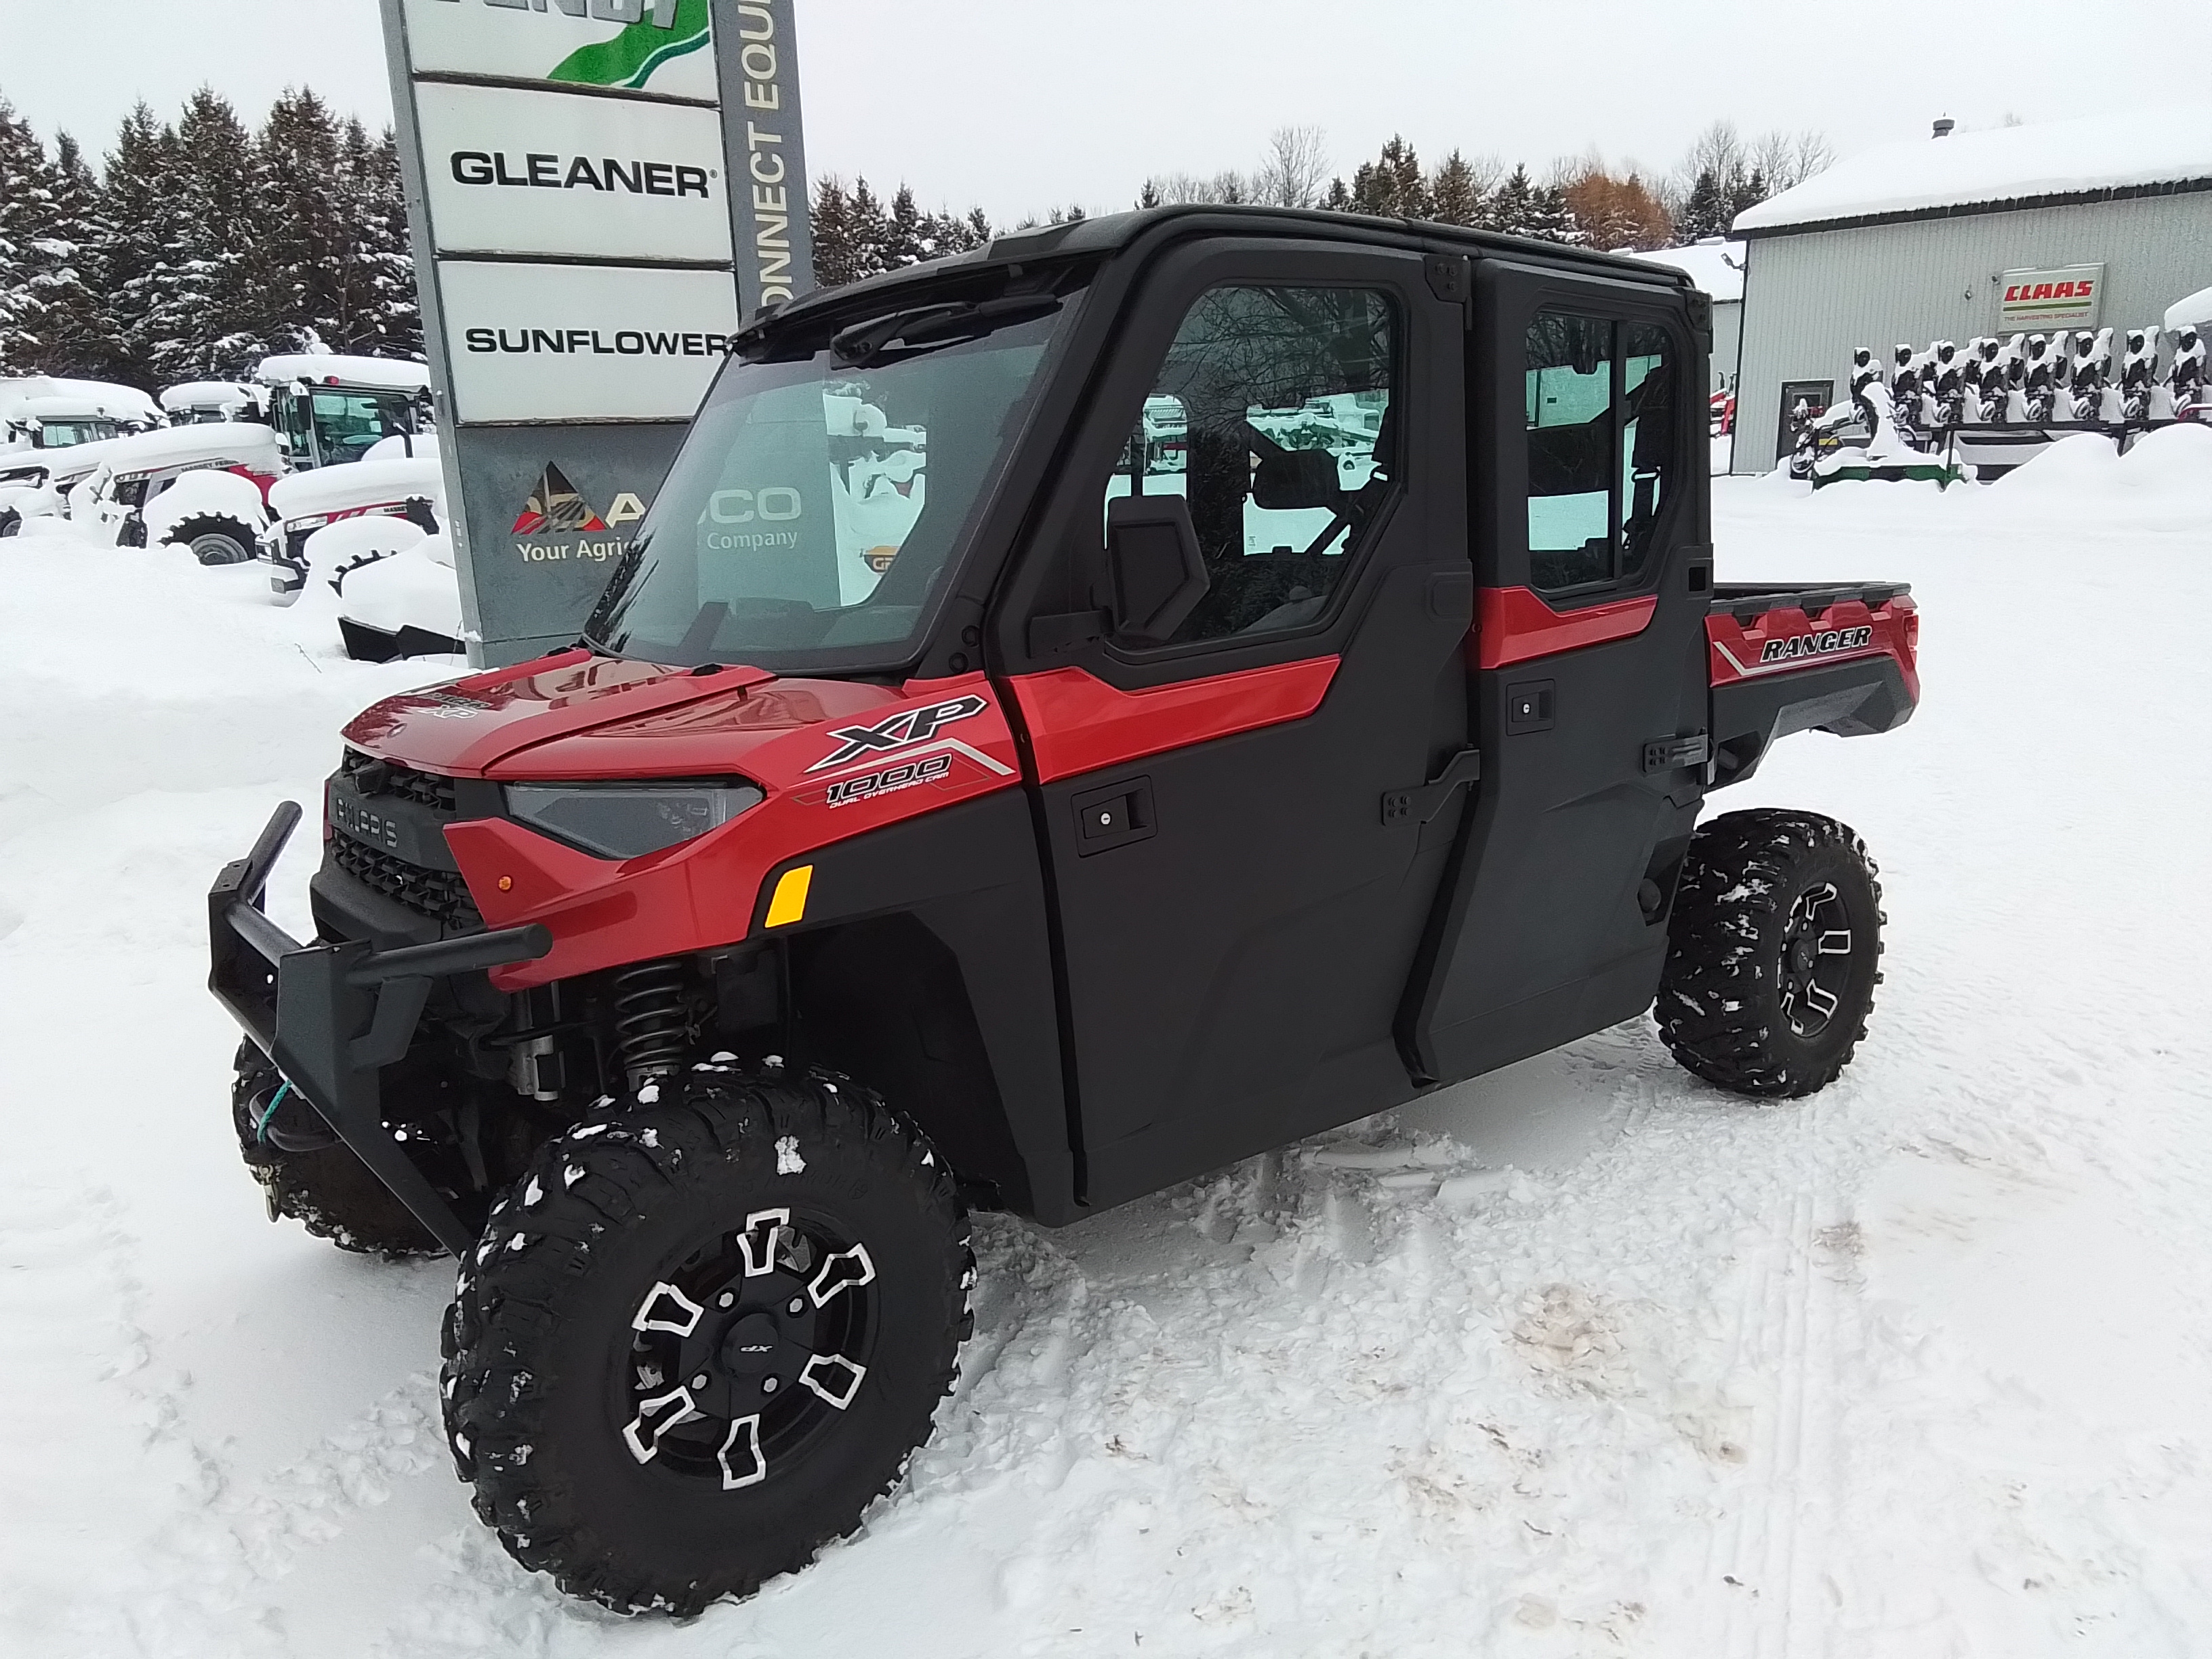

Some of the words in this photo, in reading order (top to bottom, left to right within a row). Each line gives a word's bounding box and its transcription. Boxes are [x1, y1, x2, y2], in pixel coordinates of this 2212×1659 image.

[738, 0, 781, 110] EQU
[747, 121, 794, 306] ONNECT
[2004, 280, 2095, 302] CLAAS
[466, 328, 726, 356] SUNFLOWER
[516, 543, 570, 562] Your
[707, 532, 798, 552] Company
[1760, 626, 1872, 663] RANGER
[803, 694, 987, 773] XP
[826, 753, 952, 804] 1000
[829, 797, 861, 809] DUAL
[863, 779, 923, 800] OVERHEAD
[925, 771, 949, 783] CAM
